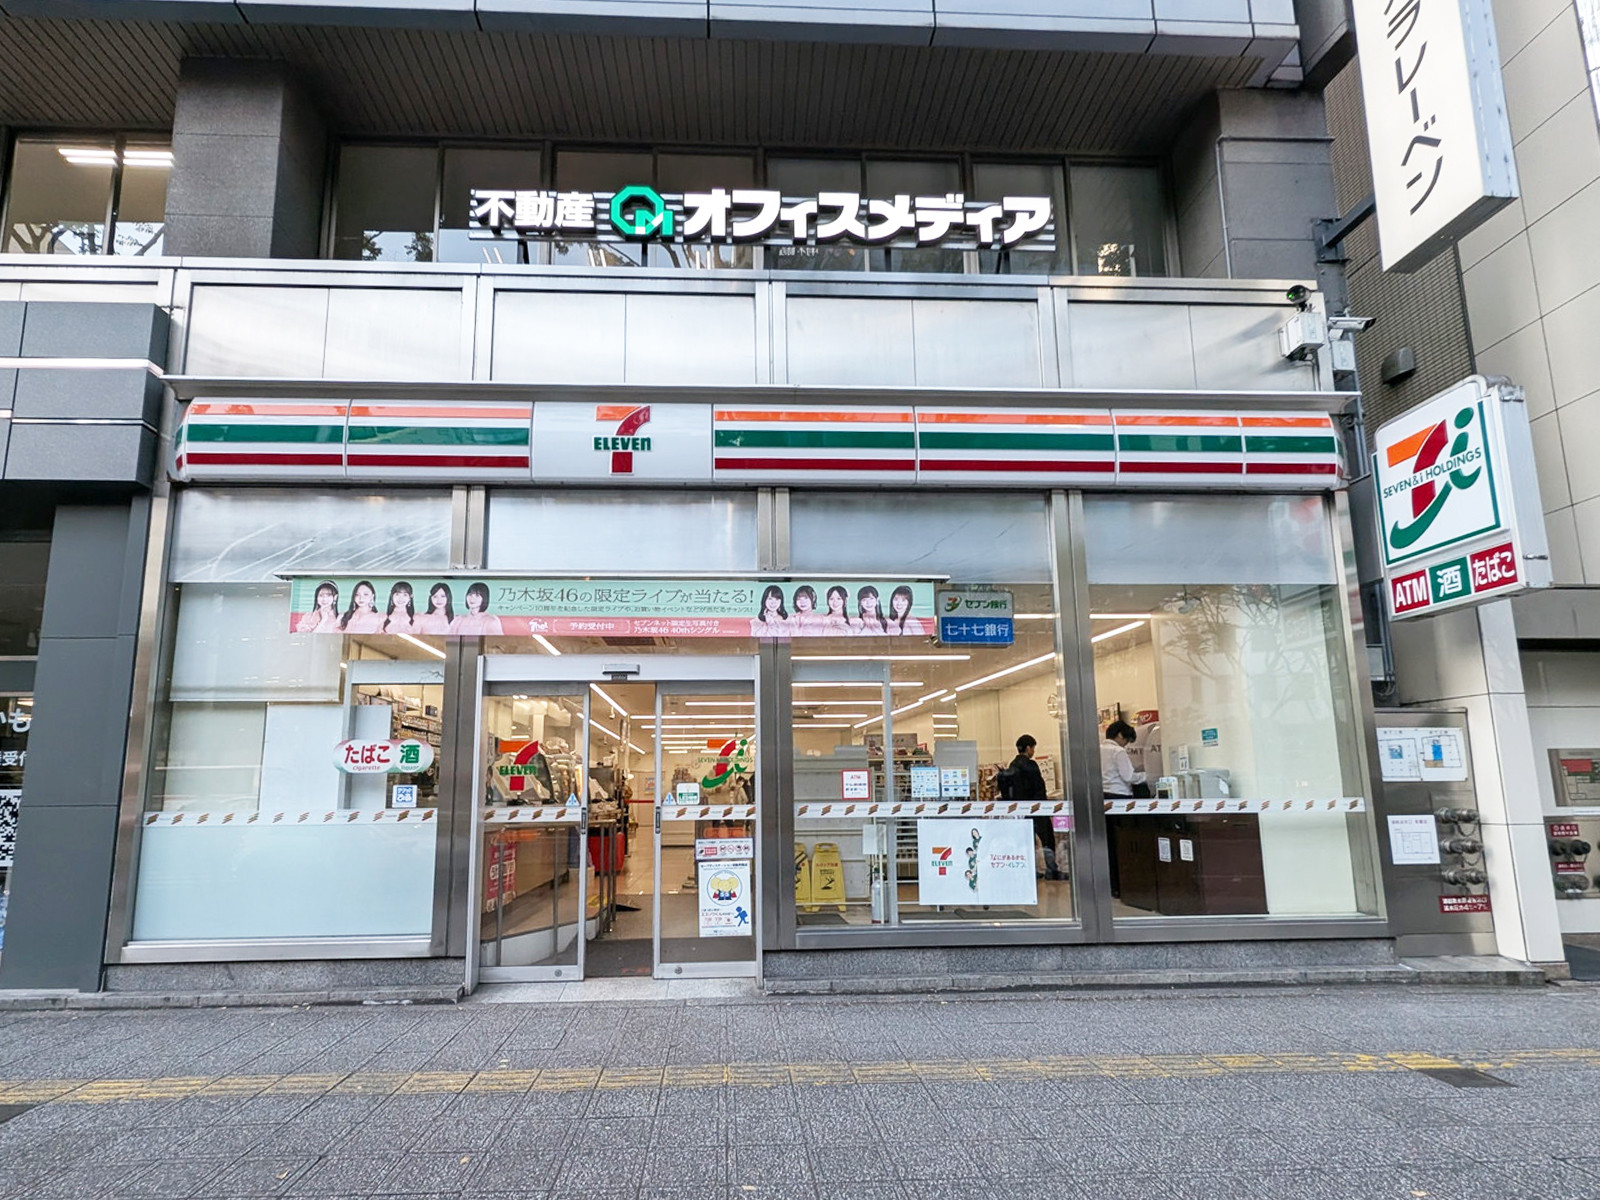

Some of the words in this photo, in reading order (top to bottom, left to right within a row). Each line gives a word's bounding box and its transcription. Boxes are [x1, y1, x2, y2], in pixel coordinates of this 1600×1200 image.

[1384, 0, 1443, 215] ラレーベン
[472, 190, 594, 227] 不動産
[683, 188, 1051, 244] オフィスメディア
[1426, 447, 1482, 480] HOLDINGS
[1436, 564, 1462, 598] 酒
[1473, 552, 1516, 587] たばこ
[1395, 575, 1428, 608] ATM
[965, 600, 1008, 610] セブン銀行
[569, 622, 615, 631] 予約受付中
[633, 626, 669, 635] 乃木坂46
[671, 627, 721, 635] 40thシングル
[945, 623, 1009, 637] 七十七銀行
[344, 744, 390, 764] たばこ
[400, 744, 420, 764] 酒
